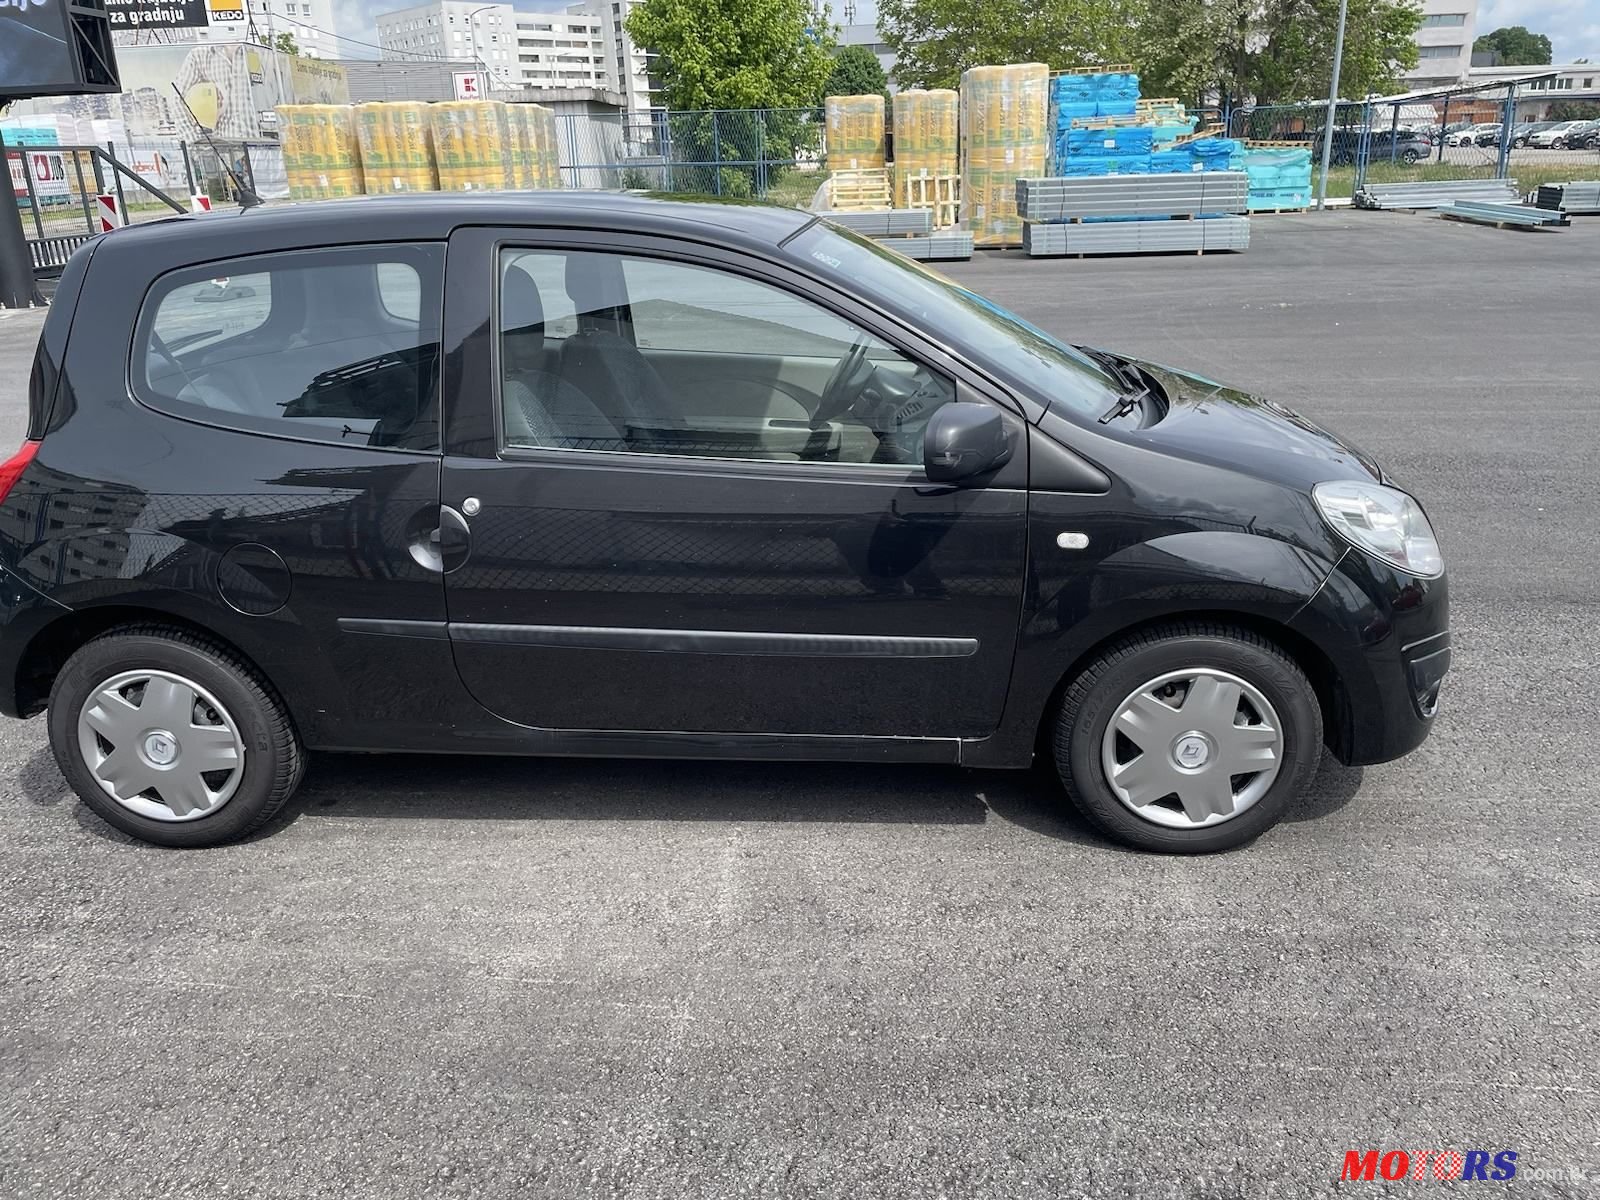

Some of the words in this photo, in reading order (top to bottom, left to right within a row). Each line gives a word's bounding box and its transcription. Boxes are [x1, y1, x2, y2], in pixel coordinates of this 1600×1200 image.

[109, 12, 126, 23] za
[129, 7, 185, 24] gradnju
[212, 10, 243, 20] KEDO
